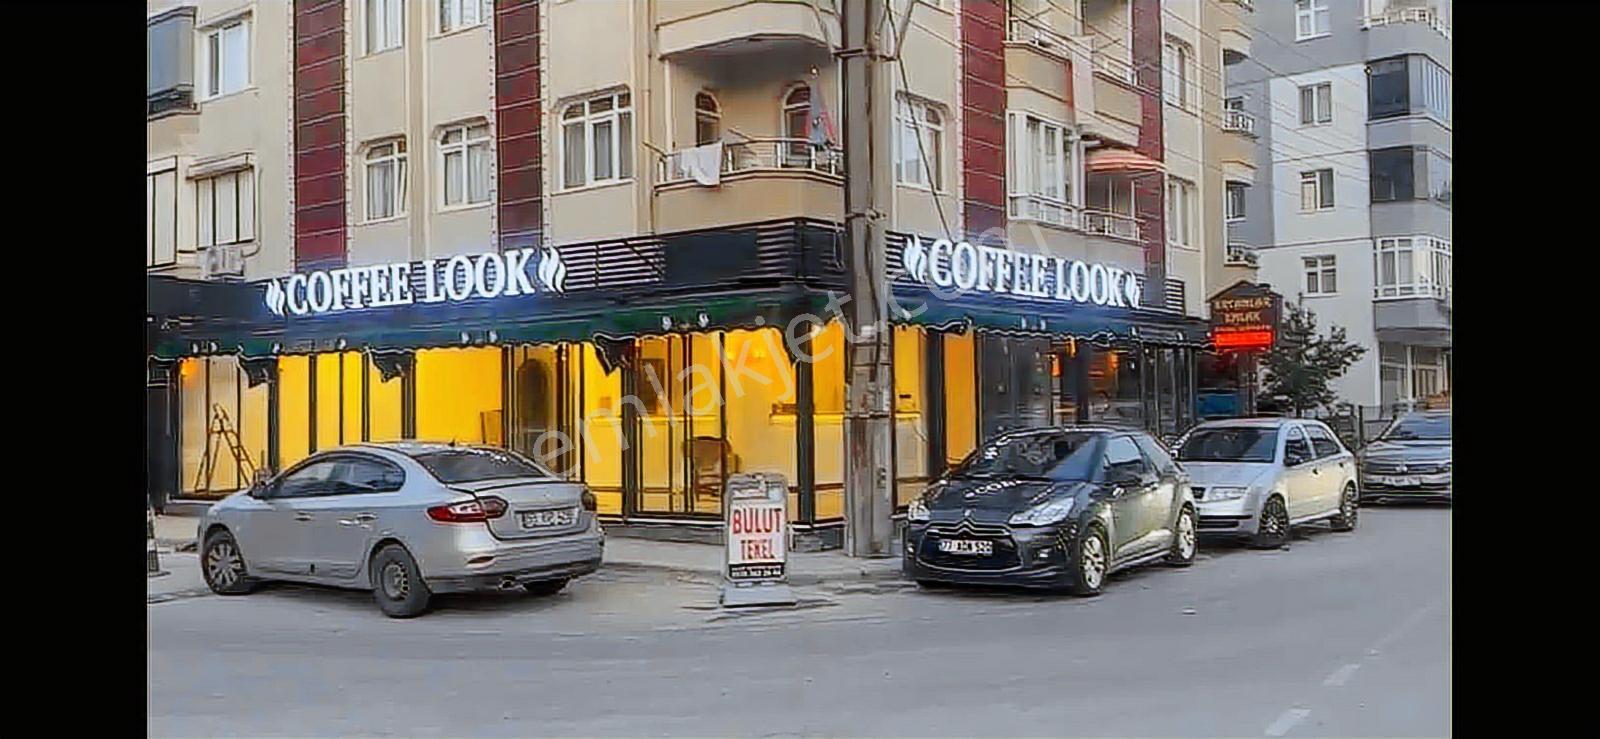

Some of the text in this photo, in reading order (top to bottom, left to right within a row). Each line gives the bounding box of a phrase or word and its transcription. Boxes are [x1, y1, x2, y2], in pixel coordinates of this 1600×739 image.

[286, 248, 535, 315] COFFEE LOOK
[929, 238, 1126, 308] COFFEE LOOK
[733, 509, 782, 533] BULUT
[740, 539, 775, 560] TEKEL
